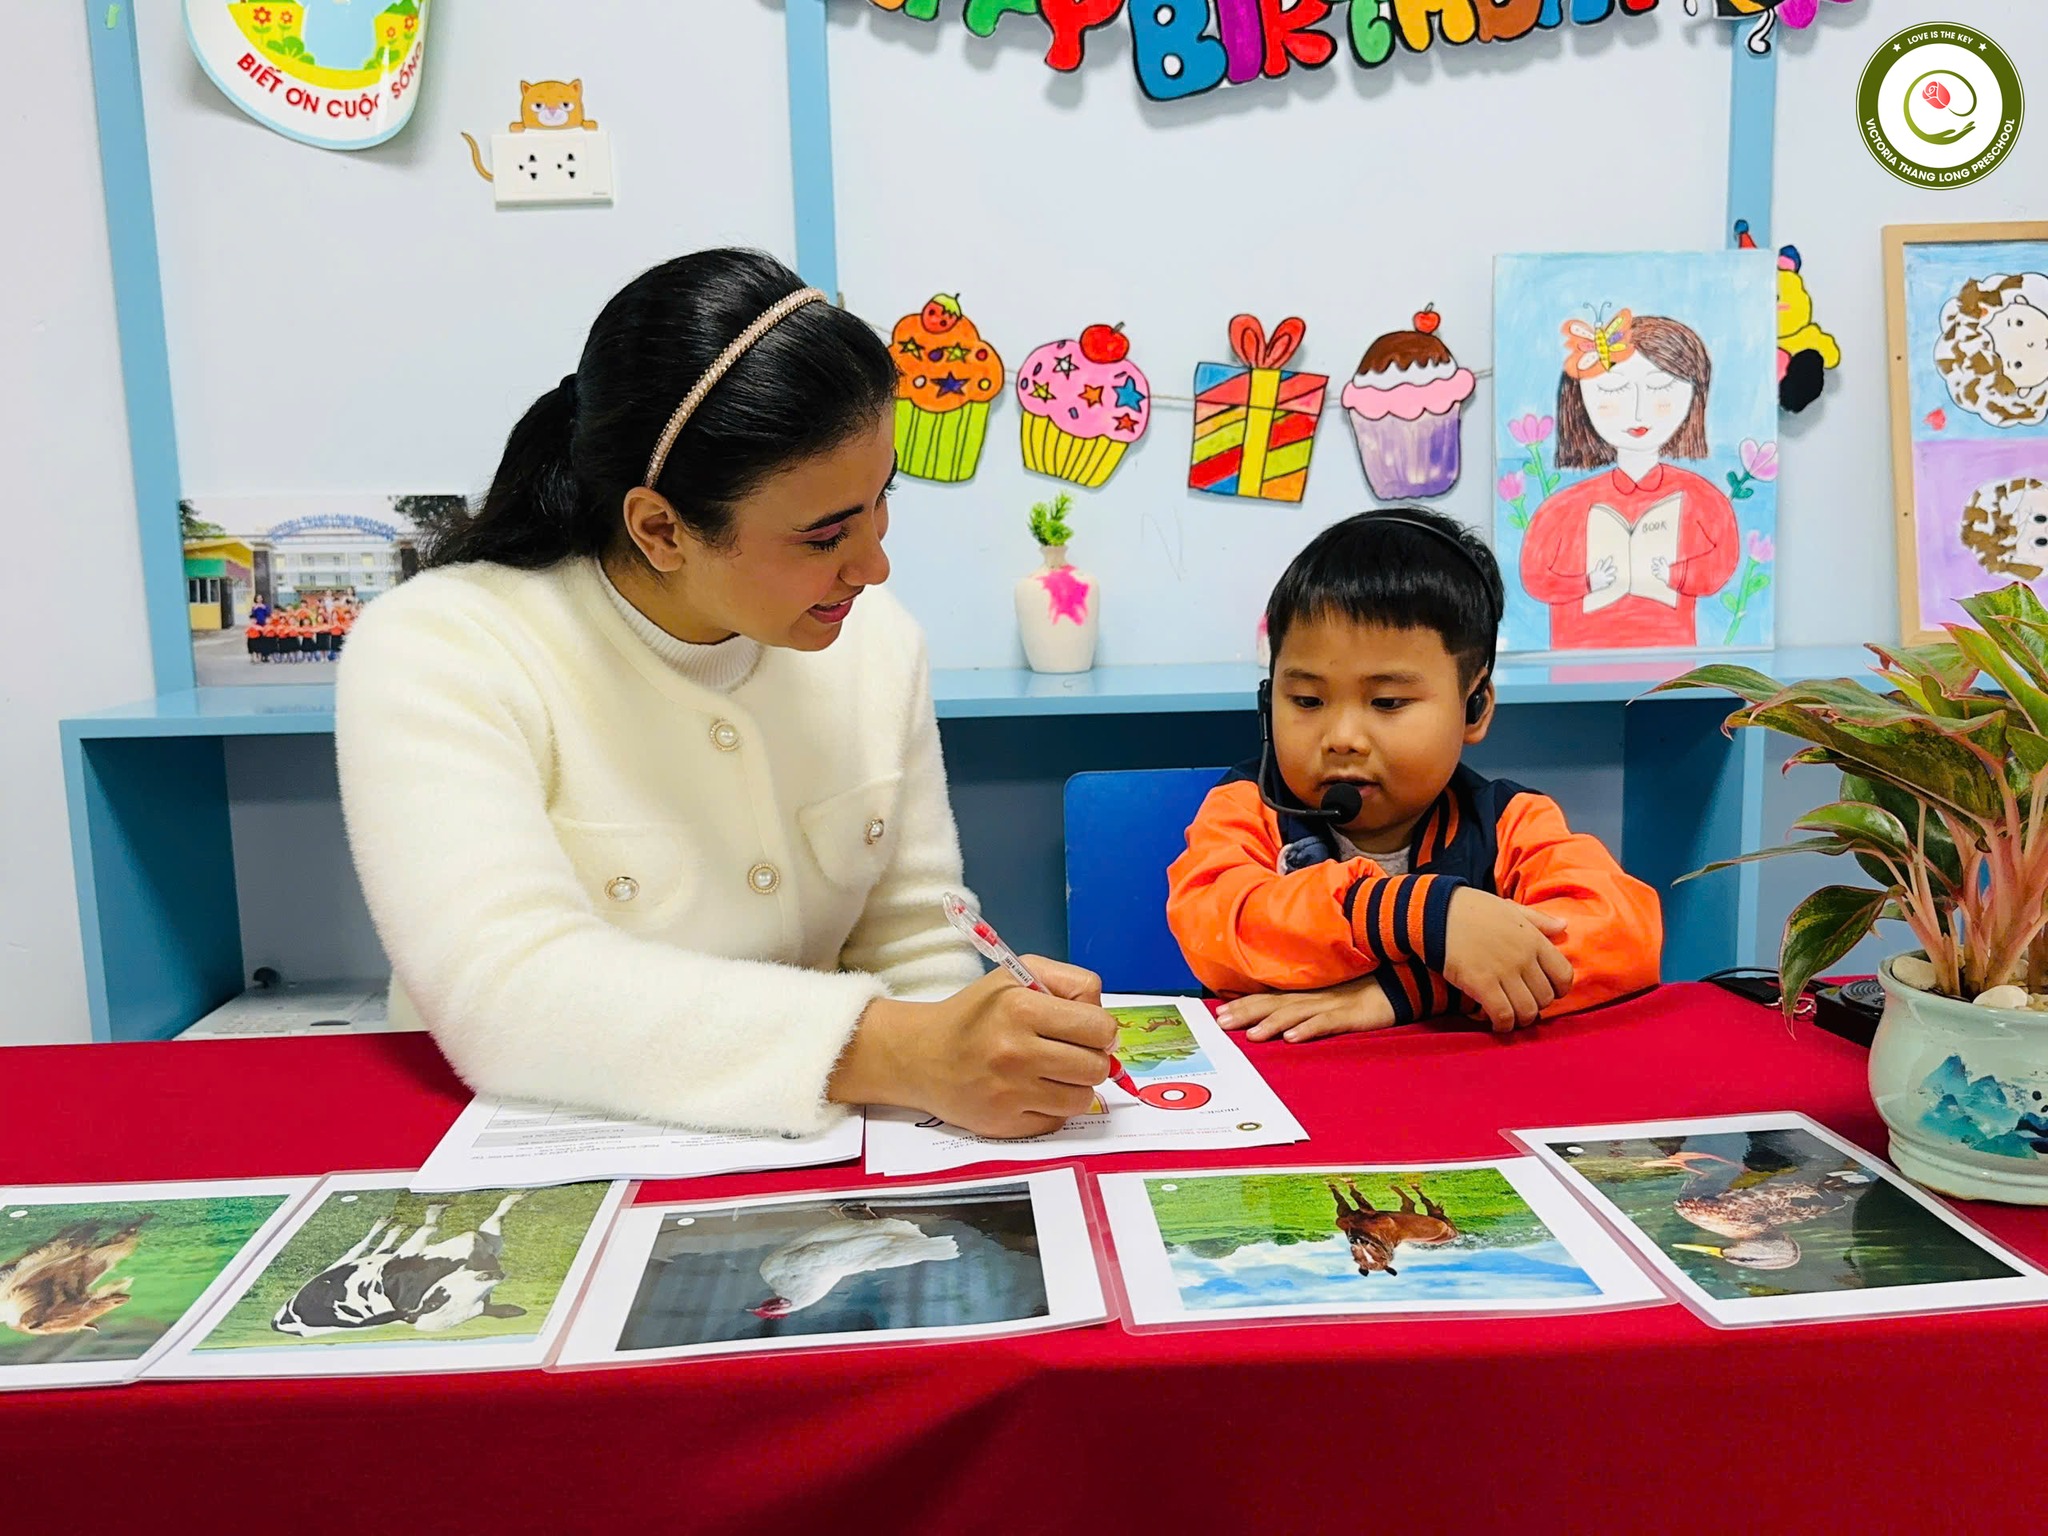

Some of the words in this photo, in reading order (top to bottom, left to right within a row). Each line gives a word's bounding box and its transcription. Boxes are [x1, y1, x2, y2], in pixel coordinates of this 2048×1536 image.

[237, 52, 284, 94] BIẾT
[285, 88, 320, 114] ƠN
[1642, 520, 1668, 533] BOOK
